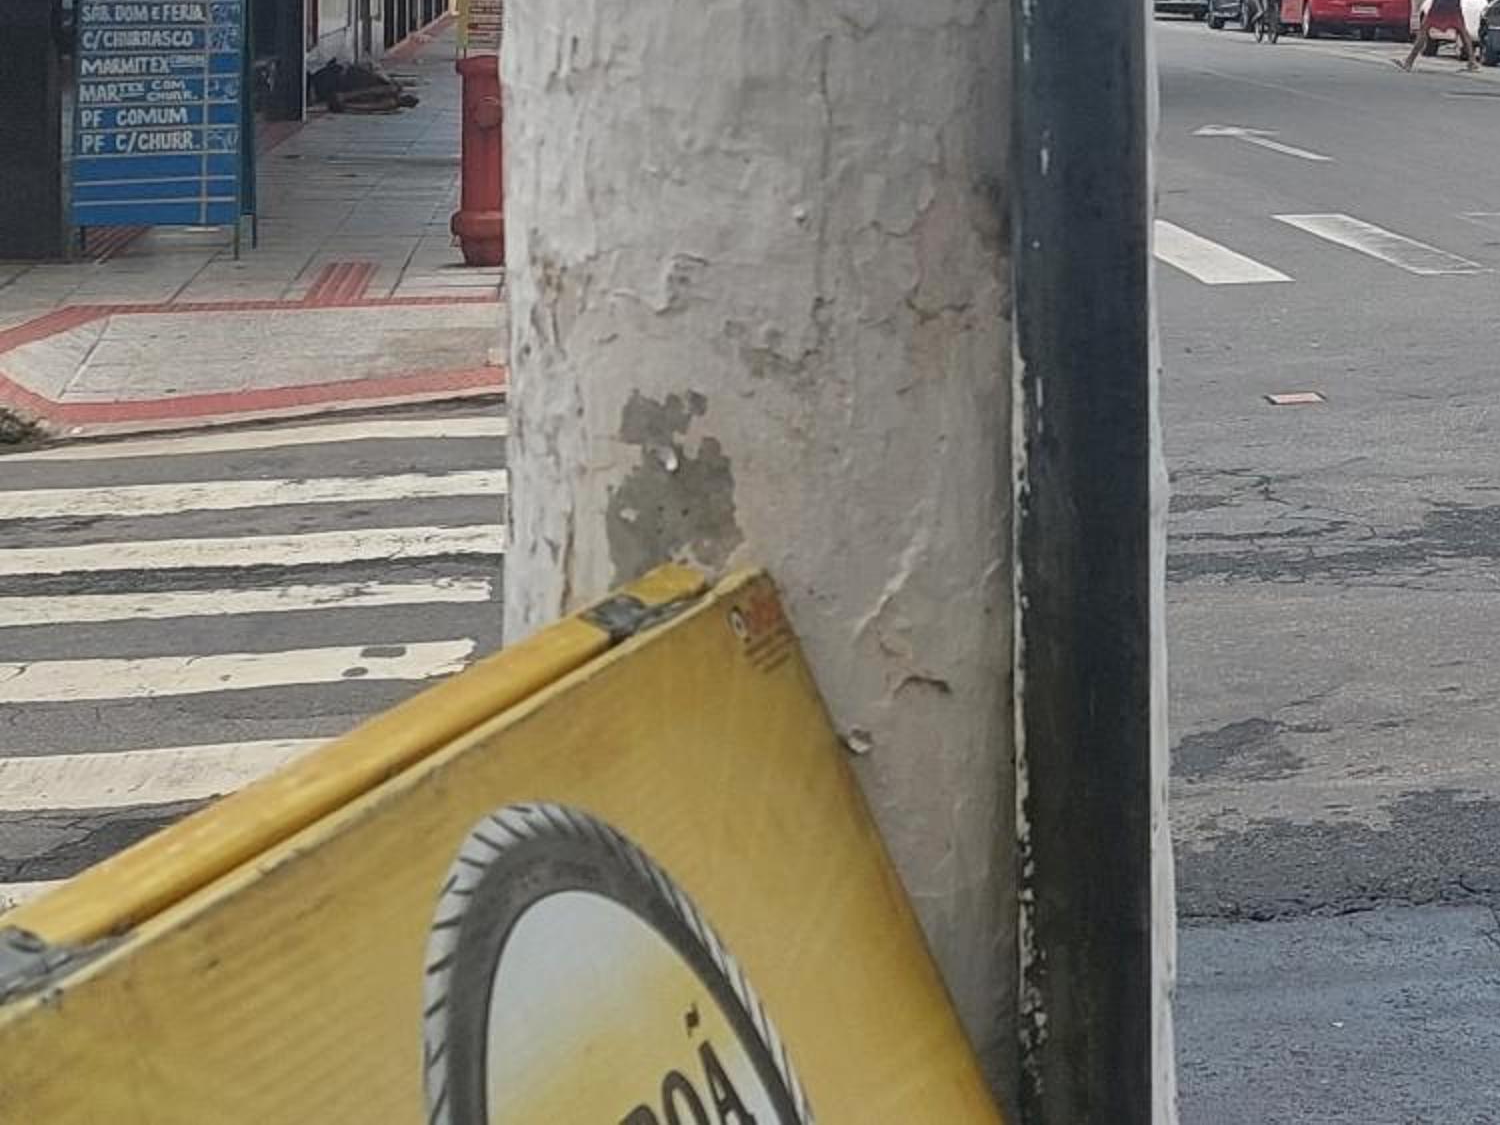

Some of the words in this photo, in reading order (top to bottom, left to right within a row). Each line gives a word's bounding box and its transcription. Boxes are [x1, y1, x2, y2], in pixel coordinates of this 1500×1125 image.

[115, 6, 148, 22] DOM
[80, 57, 170, 75] MARMITEX
[81, 110, 103, 127] PF
[116, 107, 188, 126] COMUM
[81, 134, 105, 153] PF
